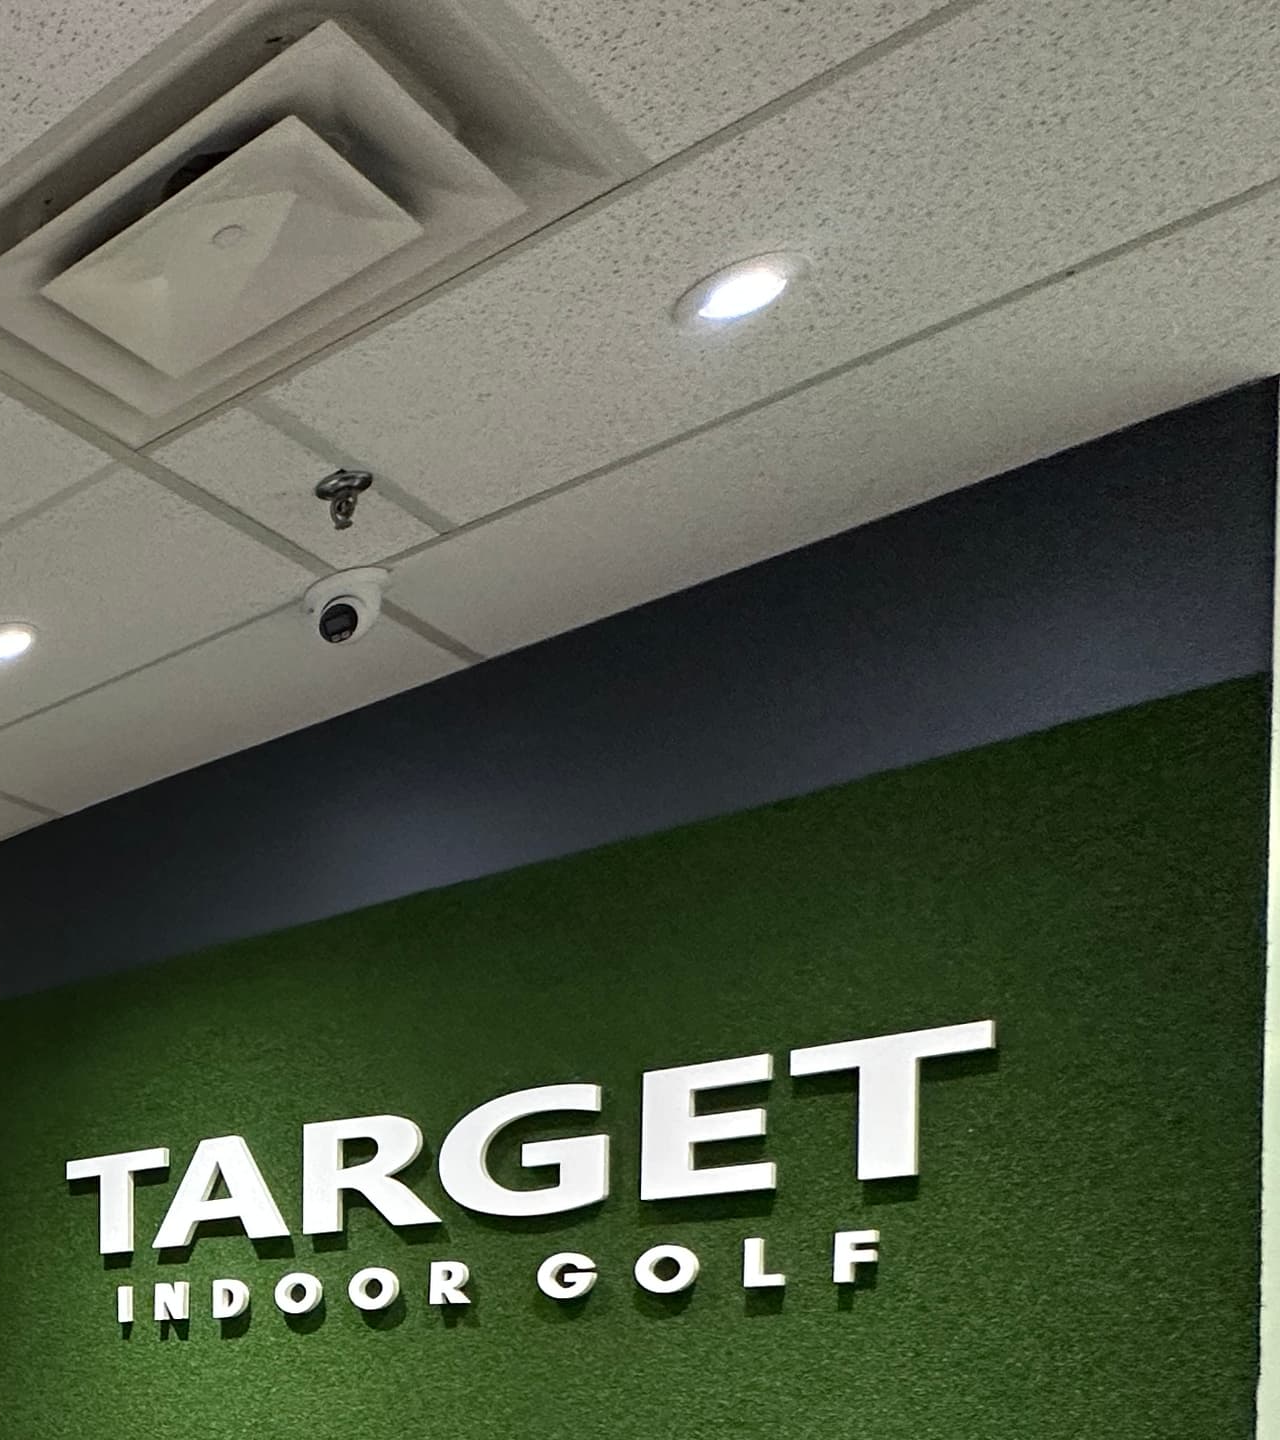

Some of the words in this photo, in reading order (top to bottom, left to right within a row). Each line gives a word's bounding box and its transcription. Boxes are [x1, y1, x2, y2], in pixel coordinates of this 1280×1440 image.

[66, 1020, 996, 1256] TARGET
[116, 1260, 472, 1324] INDOOR
[537, 1229, 881, 1300] GOLF
